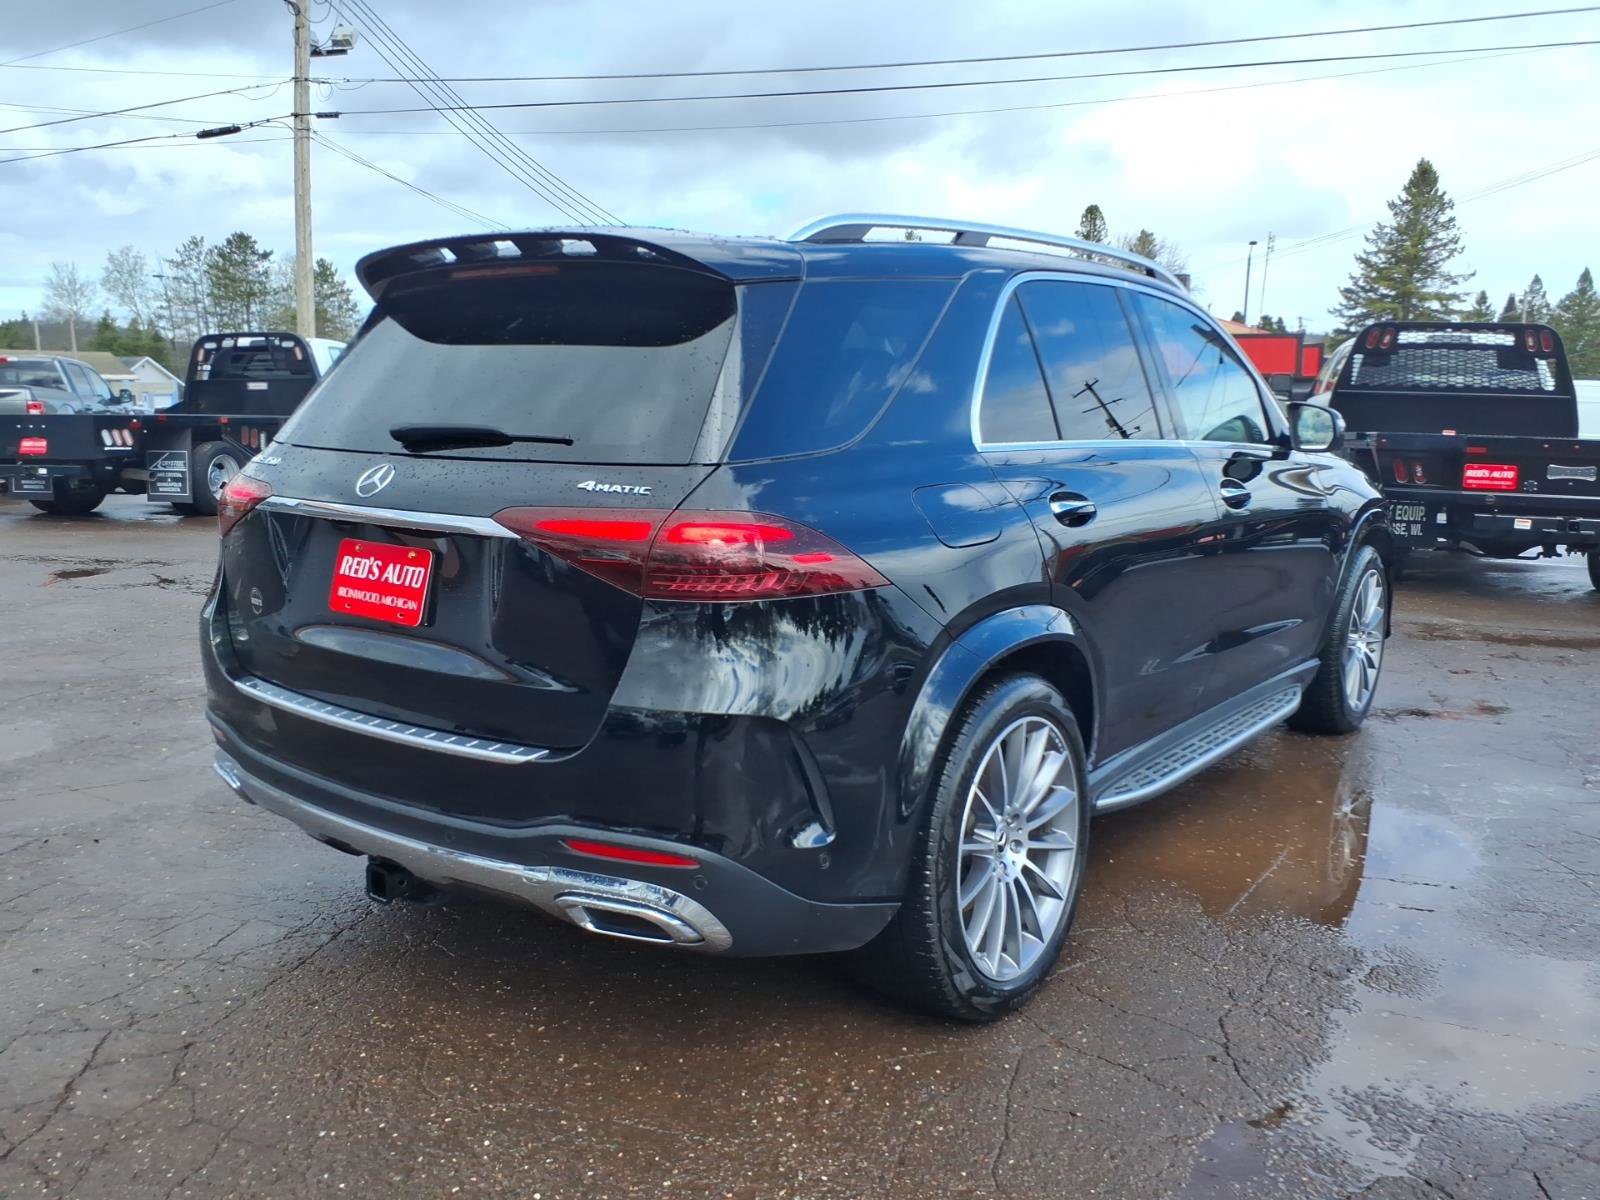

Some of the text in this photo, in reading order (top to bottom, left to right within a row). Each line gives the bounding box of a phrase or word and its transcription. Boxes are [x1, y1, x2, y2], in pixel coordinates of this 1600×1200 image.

[1490, 470, 1515, 479] AUTO
[576, 480, 653, 495] 4MATIC
[1395, 505, 1426, 521] EQUIP.
[1410, 523, 1423, 536] WI.
[339, 555, 426, 588] RED'S AUTO
[381, 594, 419, 611] MICHIGAN
